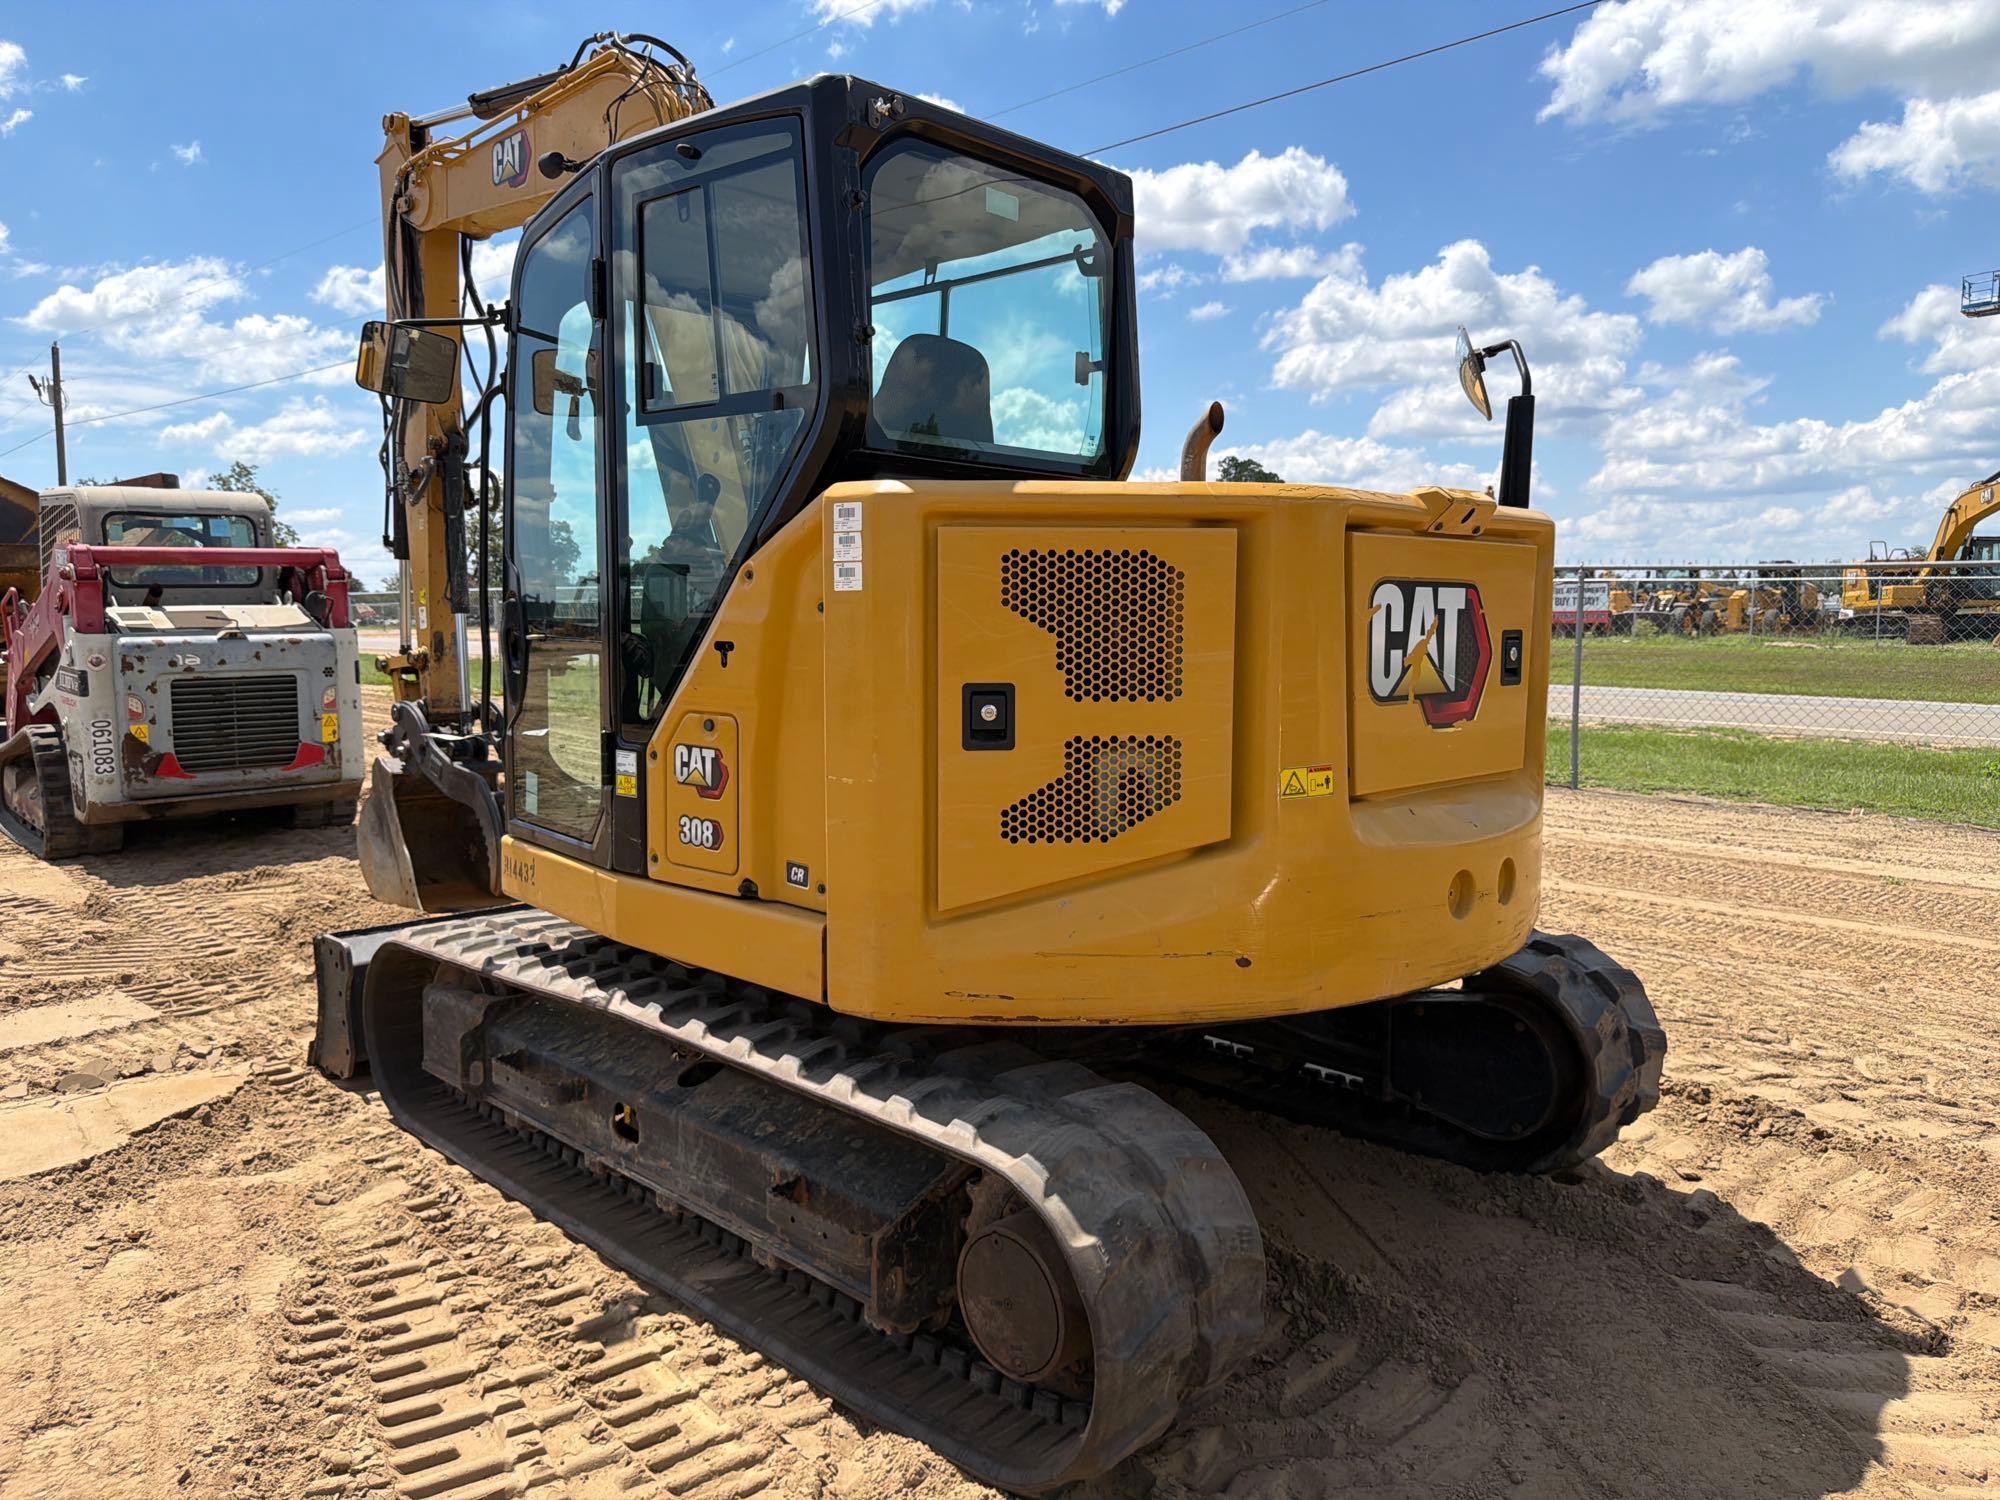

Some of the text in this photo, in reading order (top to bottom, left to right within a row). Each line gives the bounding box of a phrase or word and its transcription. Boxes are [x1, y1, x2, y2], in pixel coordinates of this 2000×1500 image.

[493, 132, 522, 184] CAT
[1555, 597, 1570, 606] BUY
[1371, 583, 1466, 697] CAT
[92, 720, 115, 775] 061083
[675, 745, 716, 788] CAT
[680, 816, 714, 848] 308
[790, 866, 805, 882] CR
